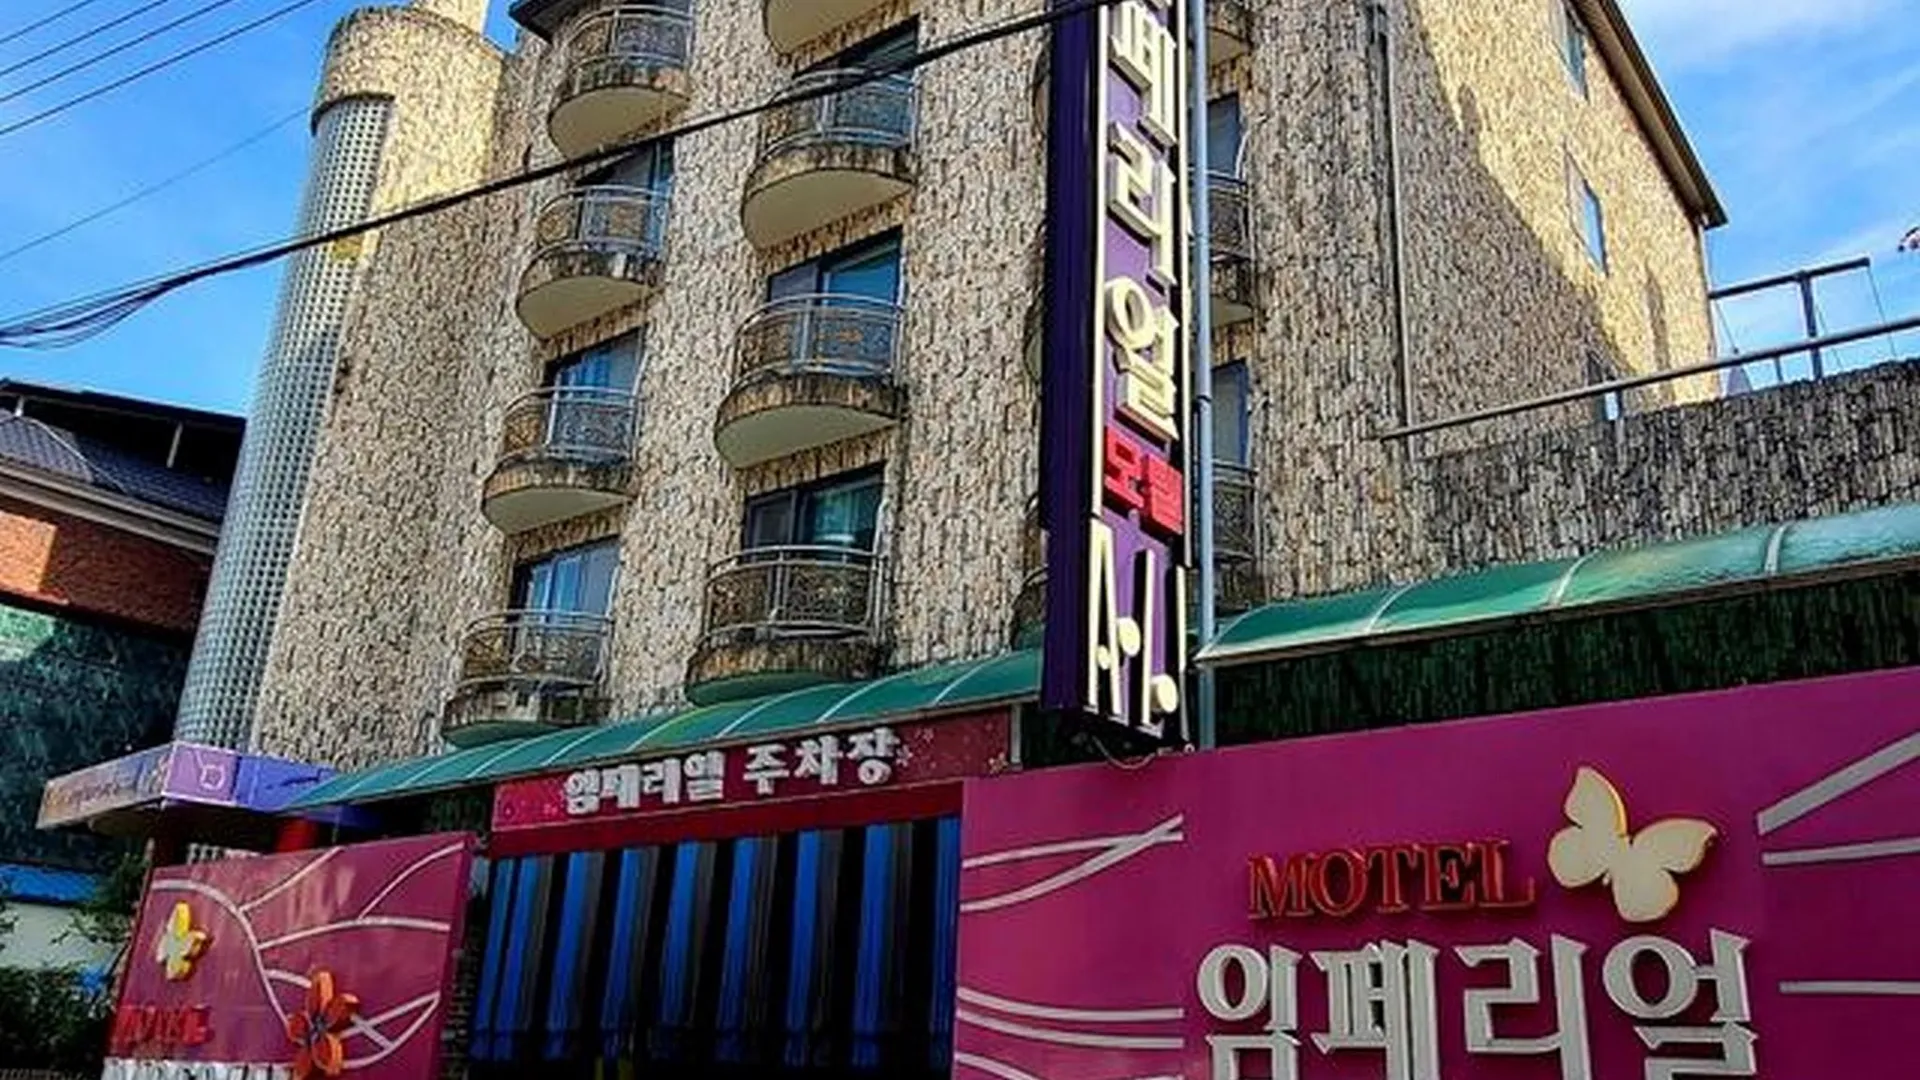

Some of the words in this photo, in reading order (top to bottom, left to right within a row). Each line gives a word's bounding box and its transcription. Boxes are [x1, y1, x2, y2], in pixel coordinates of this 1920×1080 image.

[1105, 0, 1179, 440] 페리얼
[1102, 426, 1184, 535] 모텔
[742, 726, 901, 795] 주차장
[1247, 839, 1535, 920] MOTEL
[1196, 928, 1759, 1080] 임페리얼
